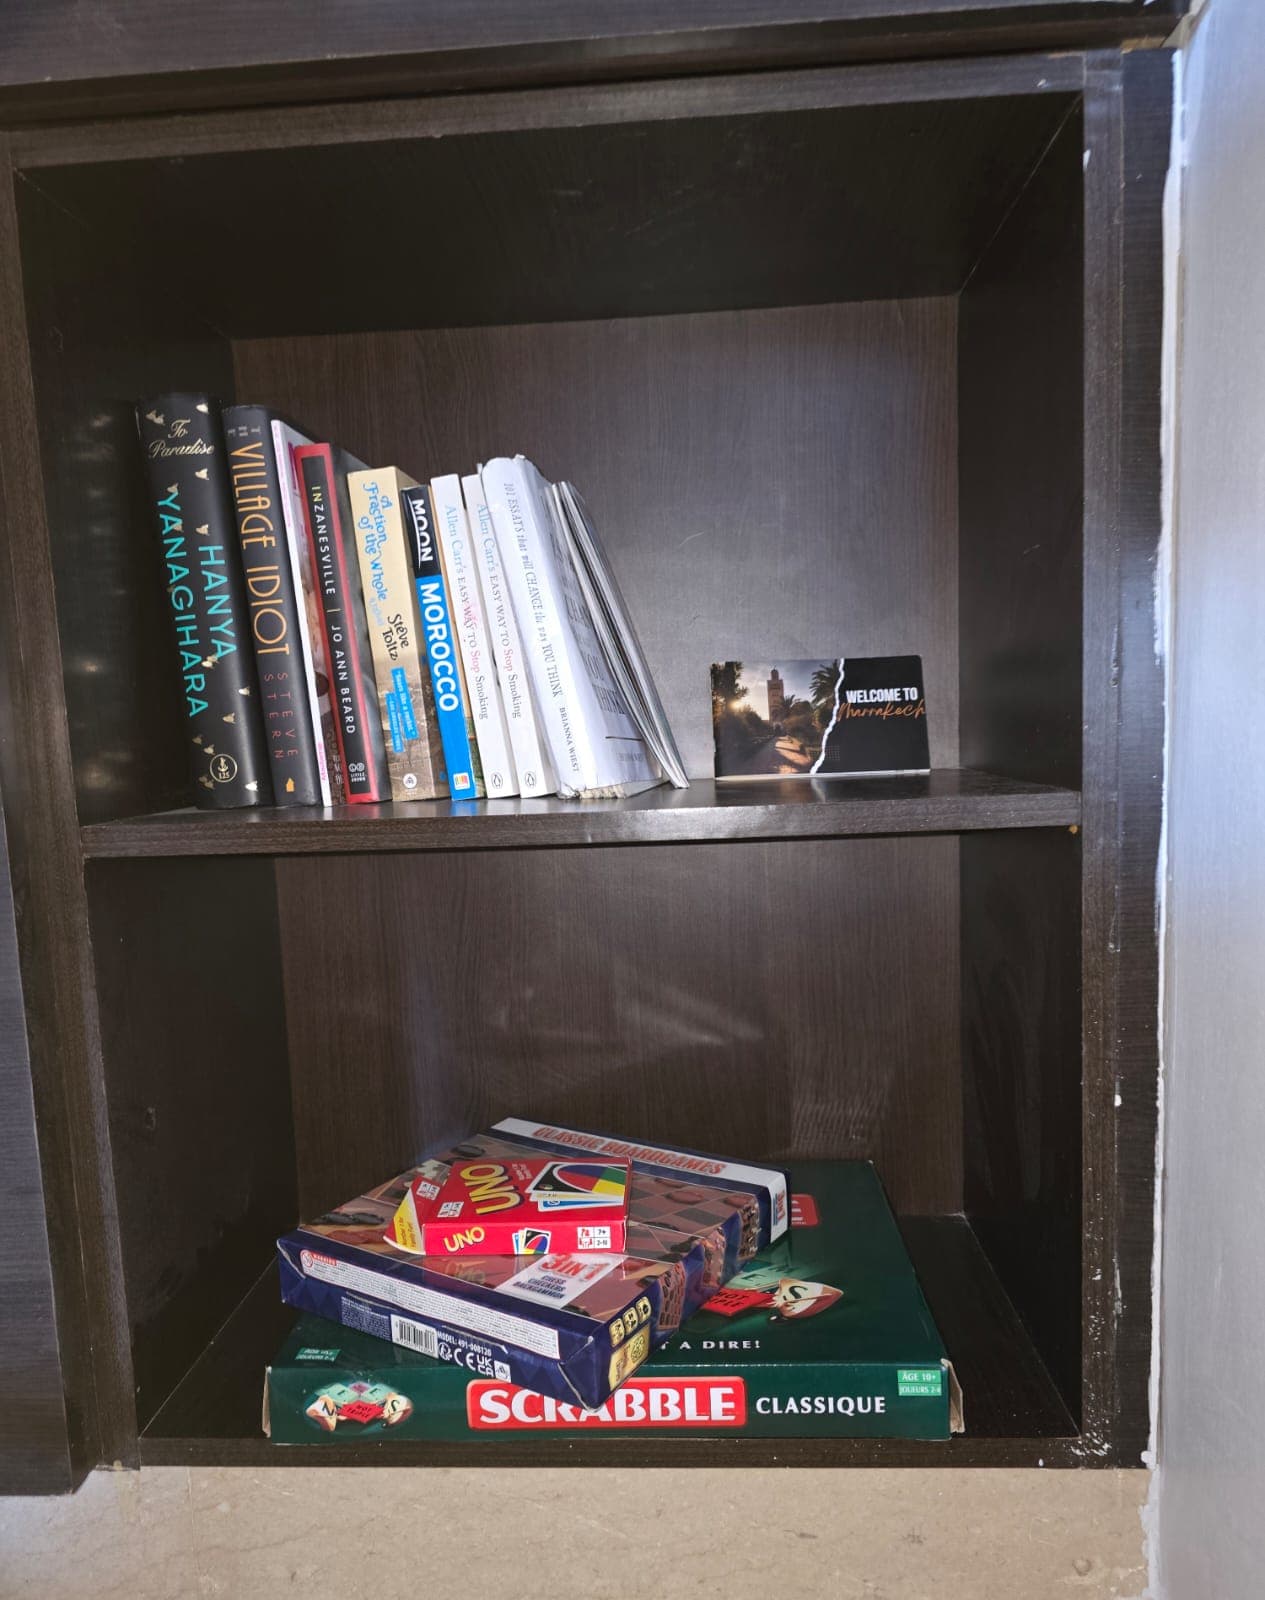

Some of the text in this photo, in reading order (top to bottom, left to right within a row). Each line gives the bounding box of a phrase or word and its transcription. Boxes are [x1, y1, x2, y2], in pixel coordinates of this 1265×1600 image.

[168, 419, 191, 439] To
[149, 438, 215, 458] Paradise
[230, 442, 276, 550] VILLAGE
[381, 495, 393, 509] A
[358, 515, 372, 530] of
[363, 481, 388, 548] Fraction
[412, 498, 434, 562] MOON
[508, 499, 526, 533] ESSAYS
[364, 533, 377, 555] the
[370, 551, 387, 601] Whole
[525, 571, 544, 610] CHANGE
[157, 490, 209, 718] YANAGIHARA
[198, 545, 238, 659] HANYA
[246, 565, 290, 655] IDIOT
[311, 486, 356, 734] INZANESVILLE JO ANN BEARD
[445, 504, 488, 720] Allen Carr's EASY WAY TO Stop Smoking
[477, 504, 522, 719] Allen Carr's EASY WAY TO Stop Smoking
[382, 628, 399, 661] Toltz
[387, 613, 409, 648] Steve
[420, 582, 459, 712] MOROCCO
[542, 644, 556, 664] YOU
[546, 665, 563, 698] THINK
[846, 687, 918, 704] WELCOME TO
[264, 673, 285, 760] STERN
[277, 672, 298, 757] STEVE
[837, 699, 926, 722] Marrakech
[559, 707, 580, 772] BRIANNA WIEST
[532, 1126, 605, 1150] CLASSIC
[460, 1164, 521, 1214] UNO
[443, 1226, 485, 1252] UNO
[512, 1281, 565, 1299] BACKGAMMON
[702, 1340, 761, 1350] DIRE!
[755, 1396, 886, 1416] CLASSIQUE
